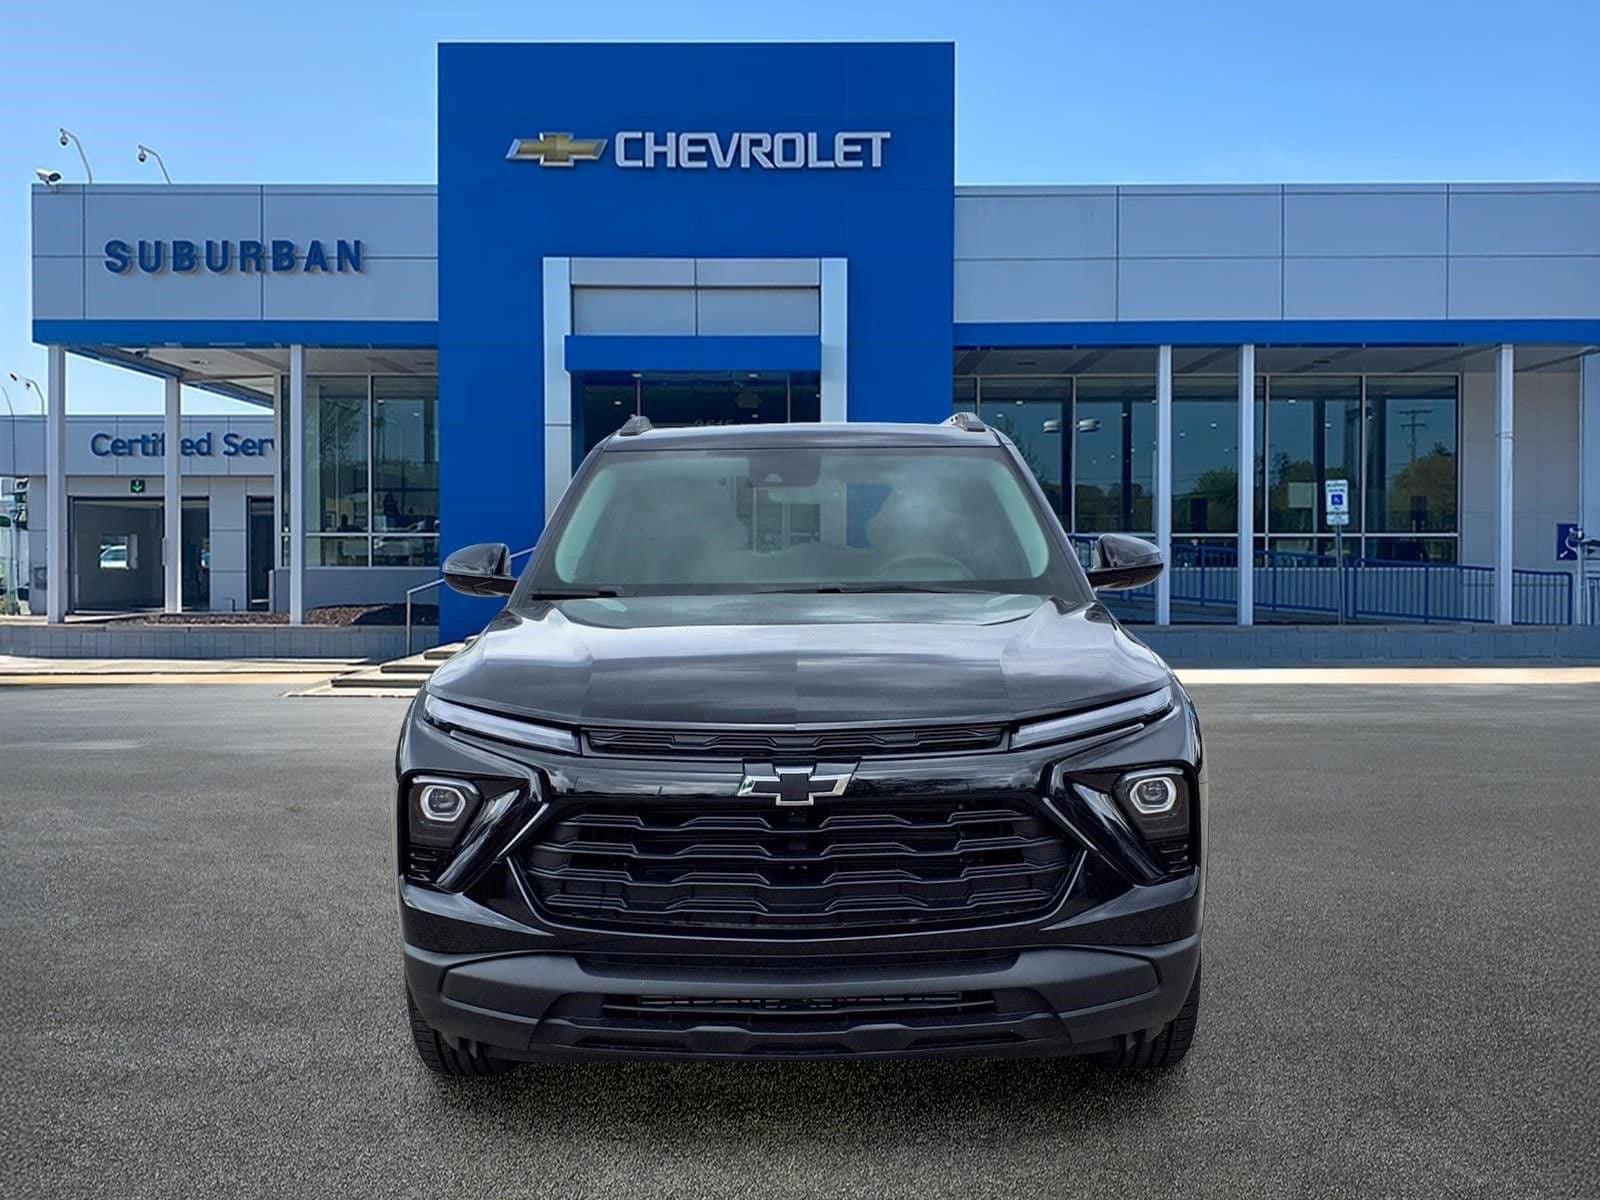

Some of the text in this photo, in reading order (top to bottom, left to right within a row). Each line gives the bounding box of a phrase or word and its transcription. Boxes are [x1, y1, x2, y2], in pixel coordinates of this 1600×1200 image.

[614, 131, 891, 169] CHEVROLET
[104, 239, 364, 273] SUBURBAN
[90, 431, 275, 457] Certifed Ser
